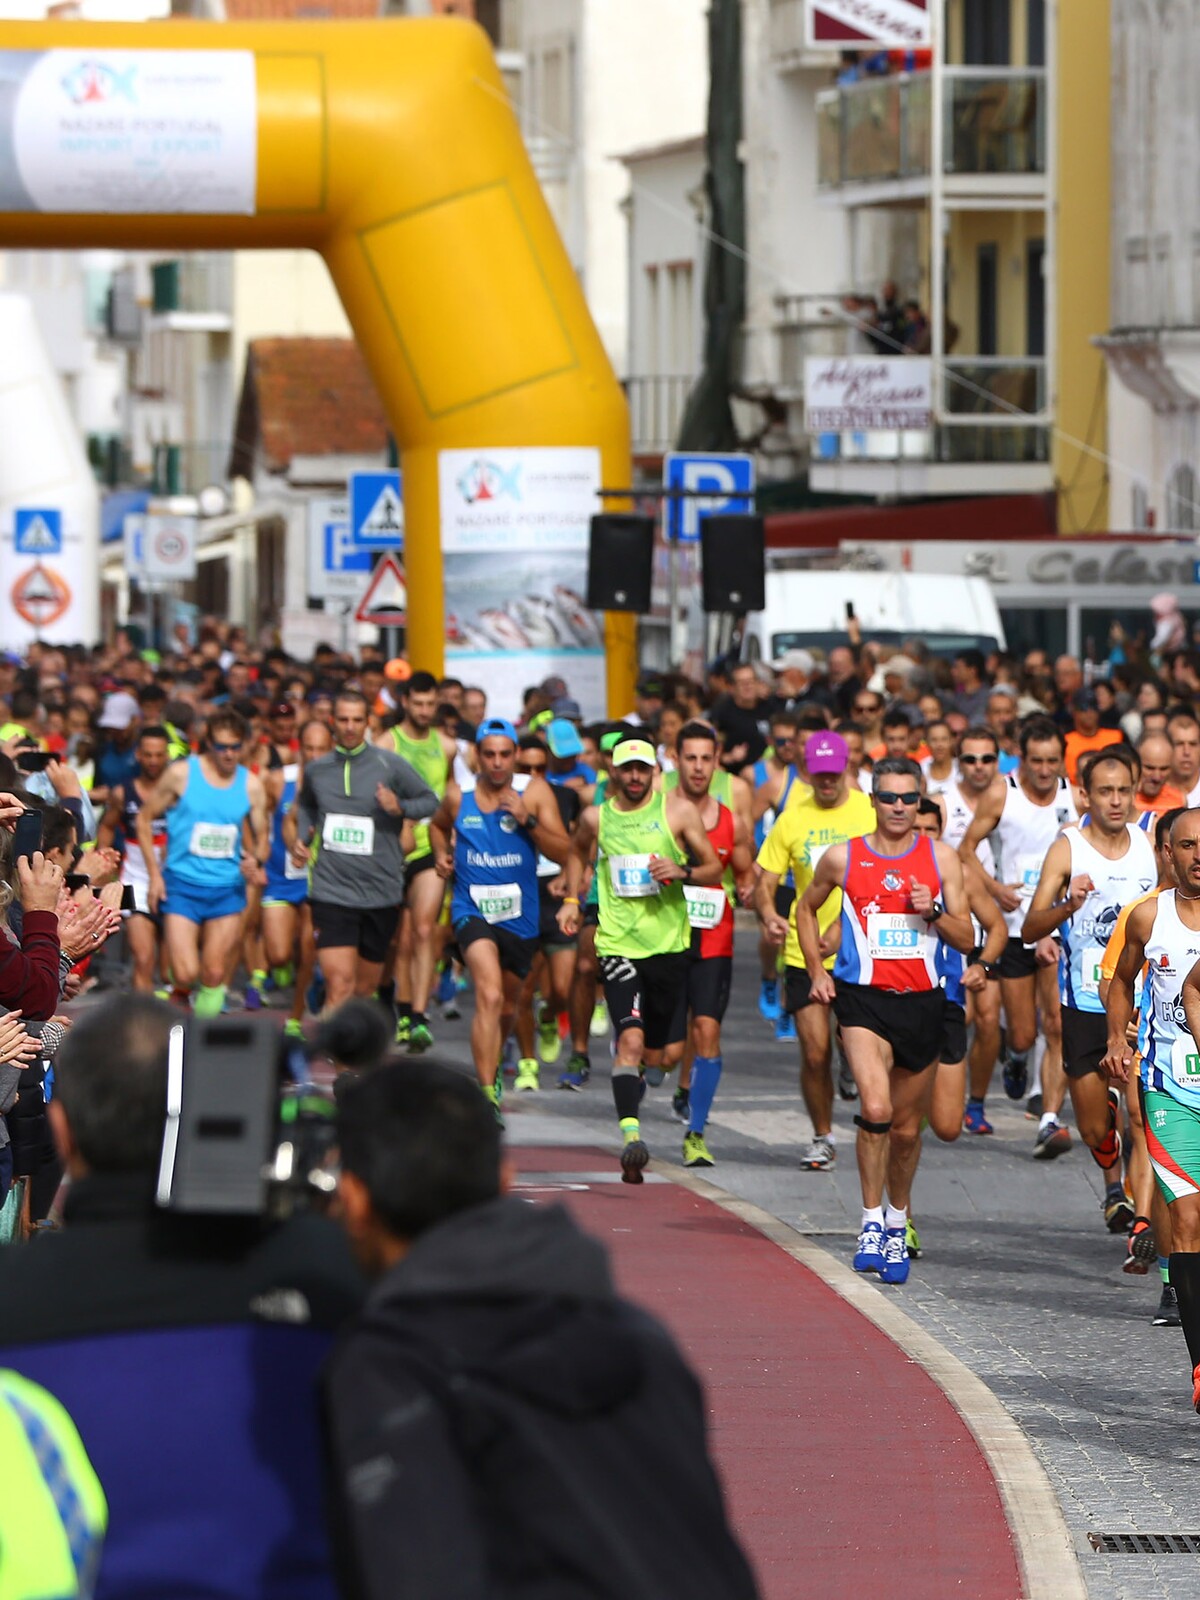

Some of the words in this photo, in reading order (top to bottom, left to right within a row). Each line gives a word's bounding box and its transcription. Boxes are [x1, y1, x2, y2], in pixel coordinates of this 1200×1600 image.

[682, 462, 736, 537] P
[624, 869, 642, 883] 20
[885, 931, 912, 946] 598
